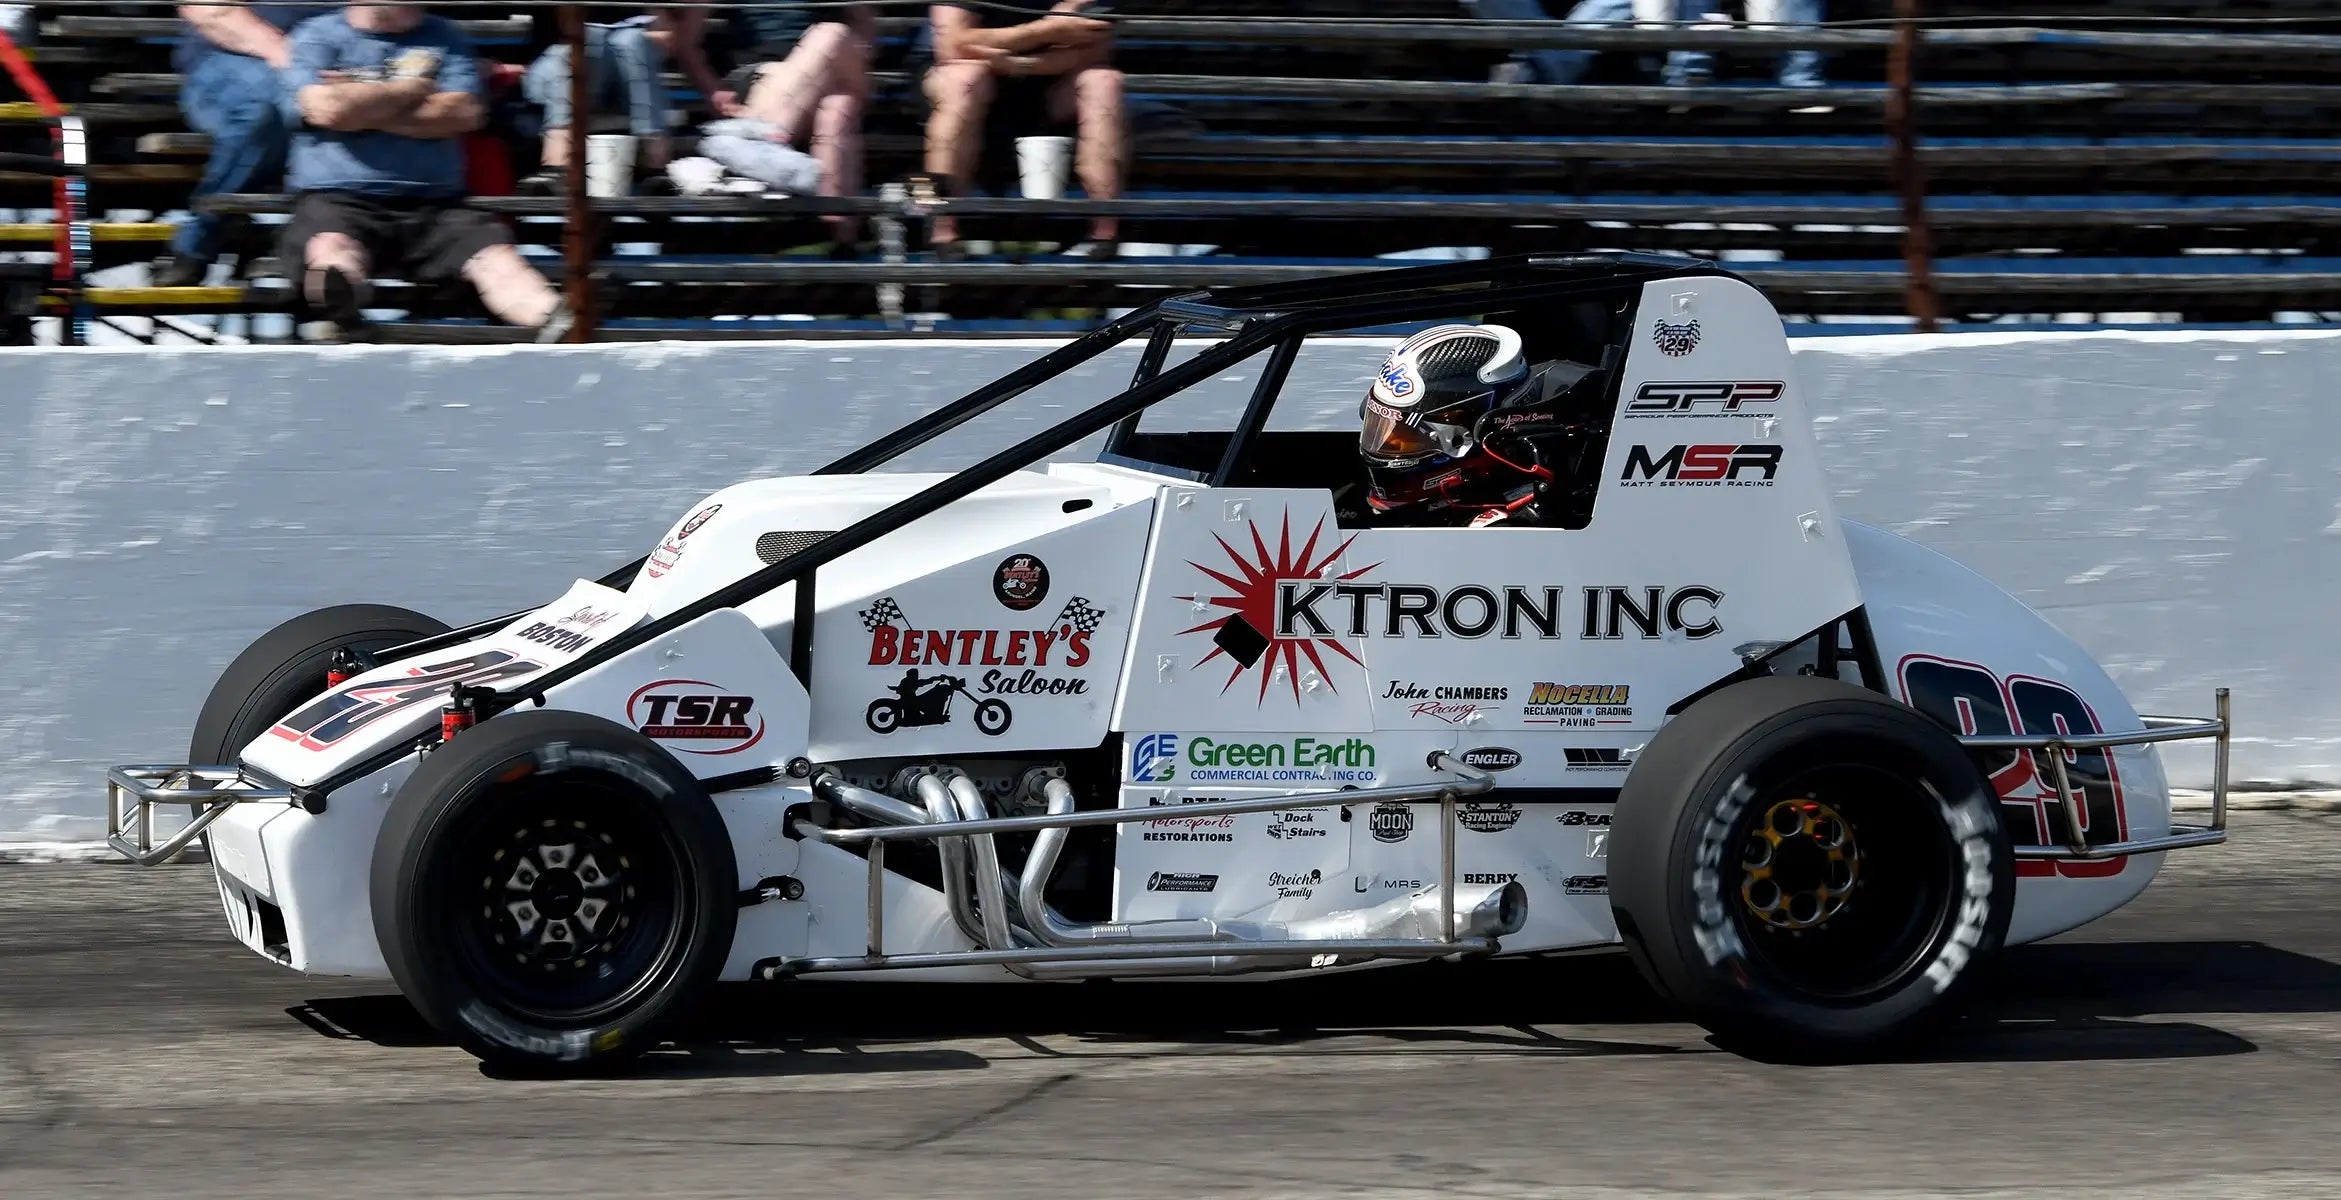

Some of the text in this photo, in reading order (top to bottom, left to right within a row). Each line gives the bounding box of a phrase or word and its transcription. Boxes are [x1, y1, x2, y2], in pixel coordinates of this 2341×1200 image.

[1664, 338, 1689, 352] 29
[1625, 380, 1786, 413] SPP
[1621, 444, 1784, 480] MSR
[1276, 579, 1726, 641] KTRON INC
[516, 621, 595, 654] BOSTON
[867, 623, 1092, 668] BENTLEY'S
[977, 668, 1089, 696] Saloon
[1382, 680, 1508, 700] John CHAMBERS
[1528, 681, 1630, 706] NOCELLA
[642, 695, 754, 726] TSR
[1408, 701, 1499, 725] Racing
[1523, 707, 1632, 716] RECLAMATION GRADING
[1560, 718, 1596, 727] PAVING
[649, 728, 746, 738] MOTORSPORTS
[1188, 736, 1285, 768] Green
[1294, 737, 1376, 768] Earth
[1465, 754, 1518, 765] ENGLER
[1897, 654, 2128, 879] 29
[1190, 769, 1377, 781] COMMERCIAL CONTRAING CO.
[1284, 813, 1314, 822] Dock
[1371, 813, 1412, 830] MOON
[1465, 812, 1513, 822] STANTON
[1289, 827, 1327, 837] Stairs
[1465, 822, 1487, 830] Racing
[1143, 832, 1233, 842] RESTORATIONS
[1384, 880, 1421, 888] MRS
[1464, 874, 1519, 885] BERRY
[1277, 887, 1313, 900] Family
